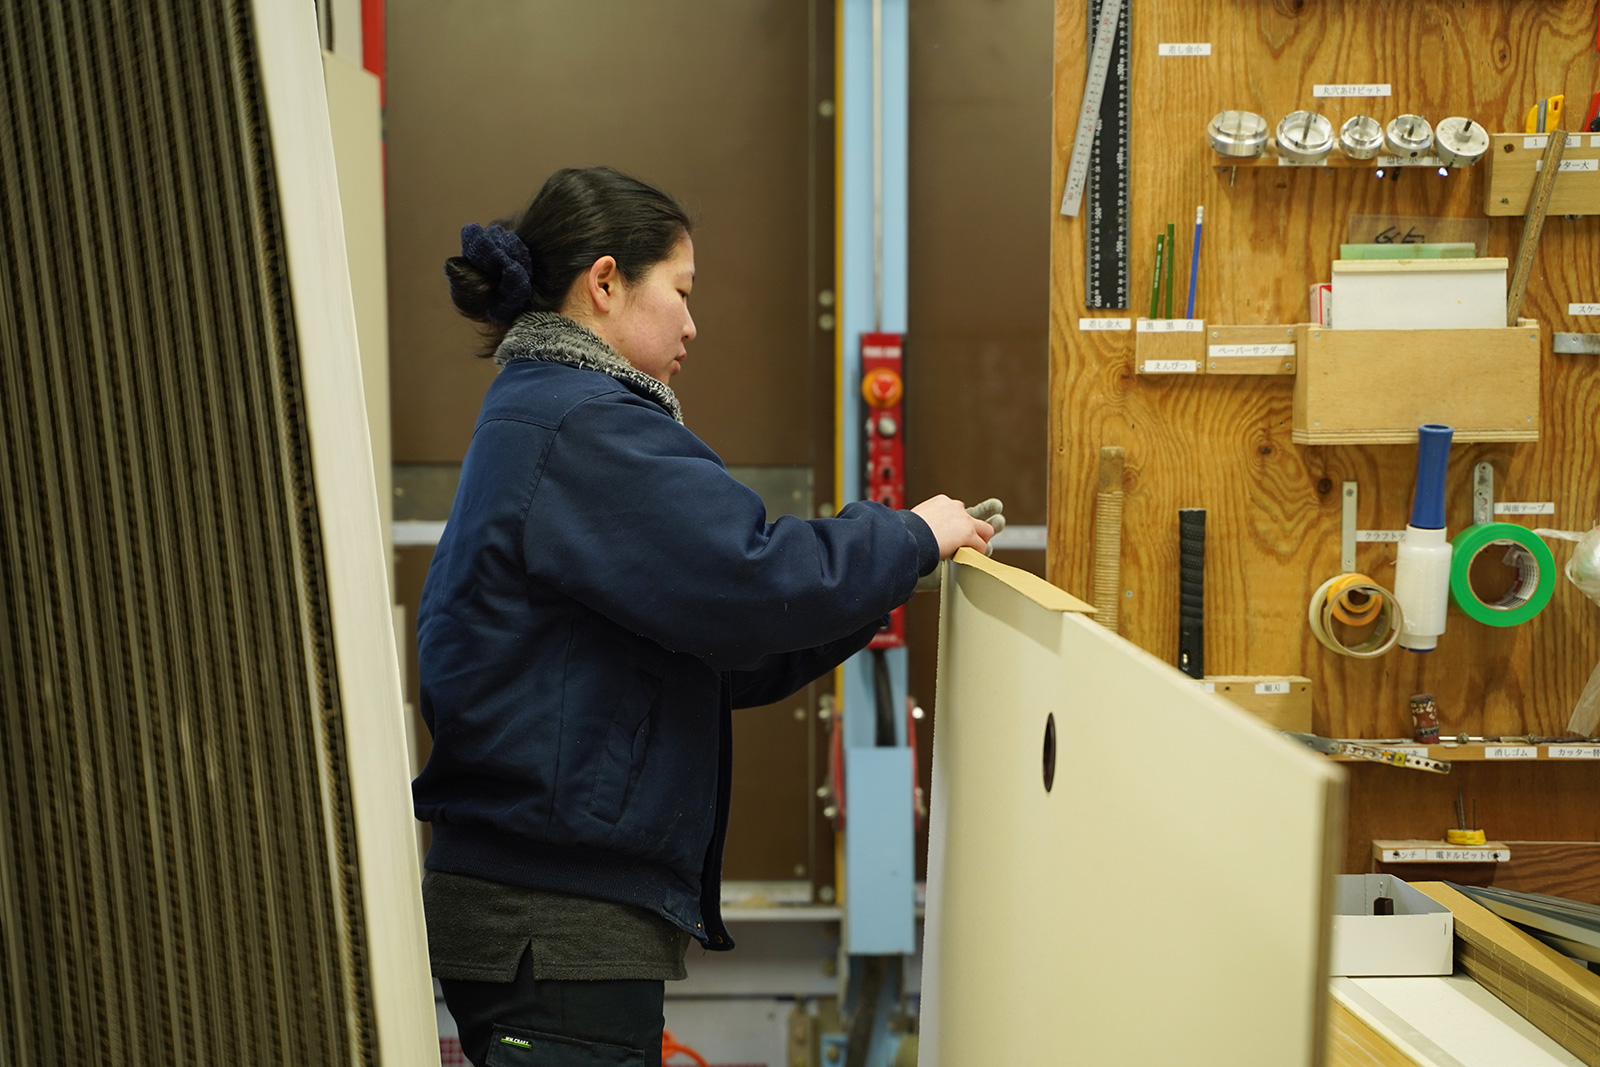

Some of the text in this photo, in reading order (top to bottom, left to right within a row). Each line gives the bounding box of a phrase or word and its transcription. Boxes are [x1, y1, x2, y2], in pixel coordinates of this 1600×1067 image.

[1559, 161, 1590, 170] ター大
[1154, 361, 1188, 371] えんぴつ
[1494, 748, 1529, 757] 消しゴム
